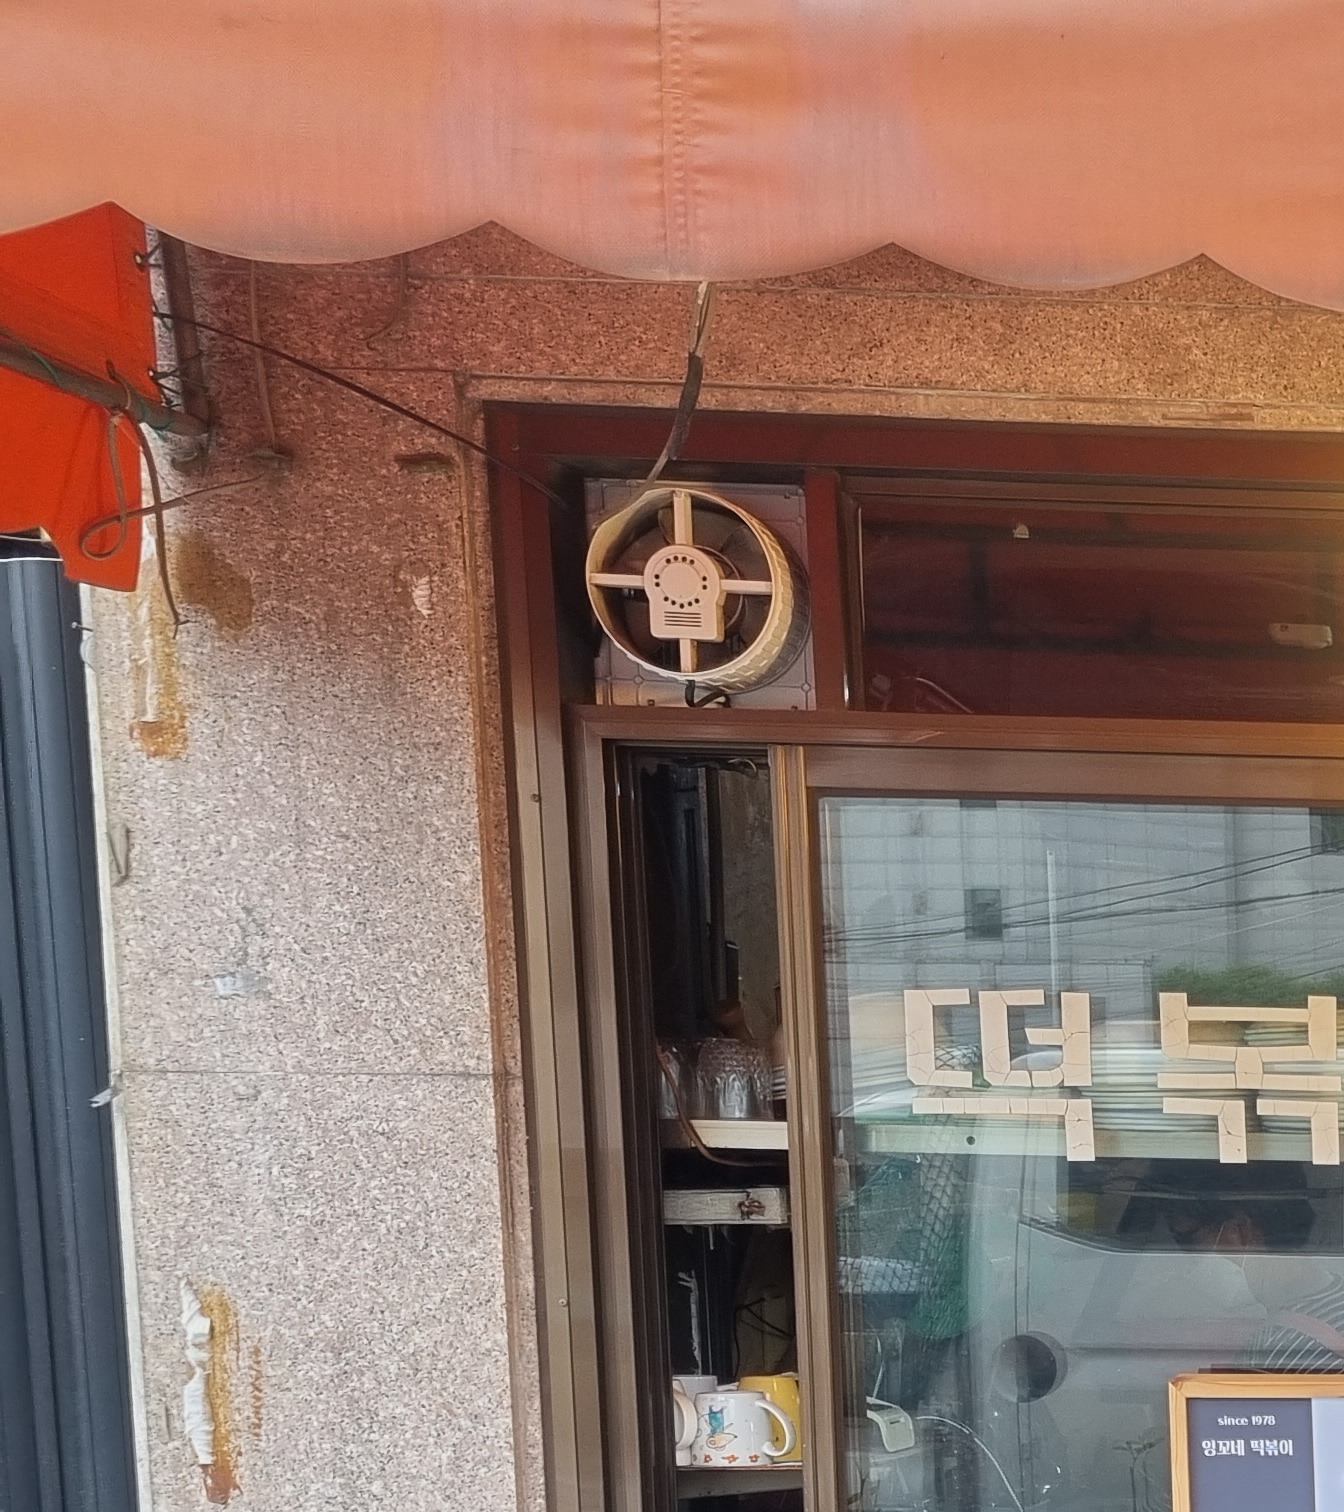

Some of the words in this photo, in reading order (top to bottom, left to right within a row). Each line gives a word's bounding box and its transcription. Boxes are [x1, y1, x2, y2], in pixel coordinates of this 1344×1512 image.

[1217, 1415, 1249, 1426] since
[1251, 1415, 1276, 1426] 1978
[1201, 1439, 1246, 1457] 잉꼬네
[1250, 1439, 1294, 1457] 떡볶이
